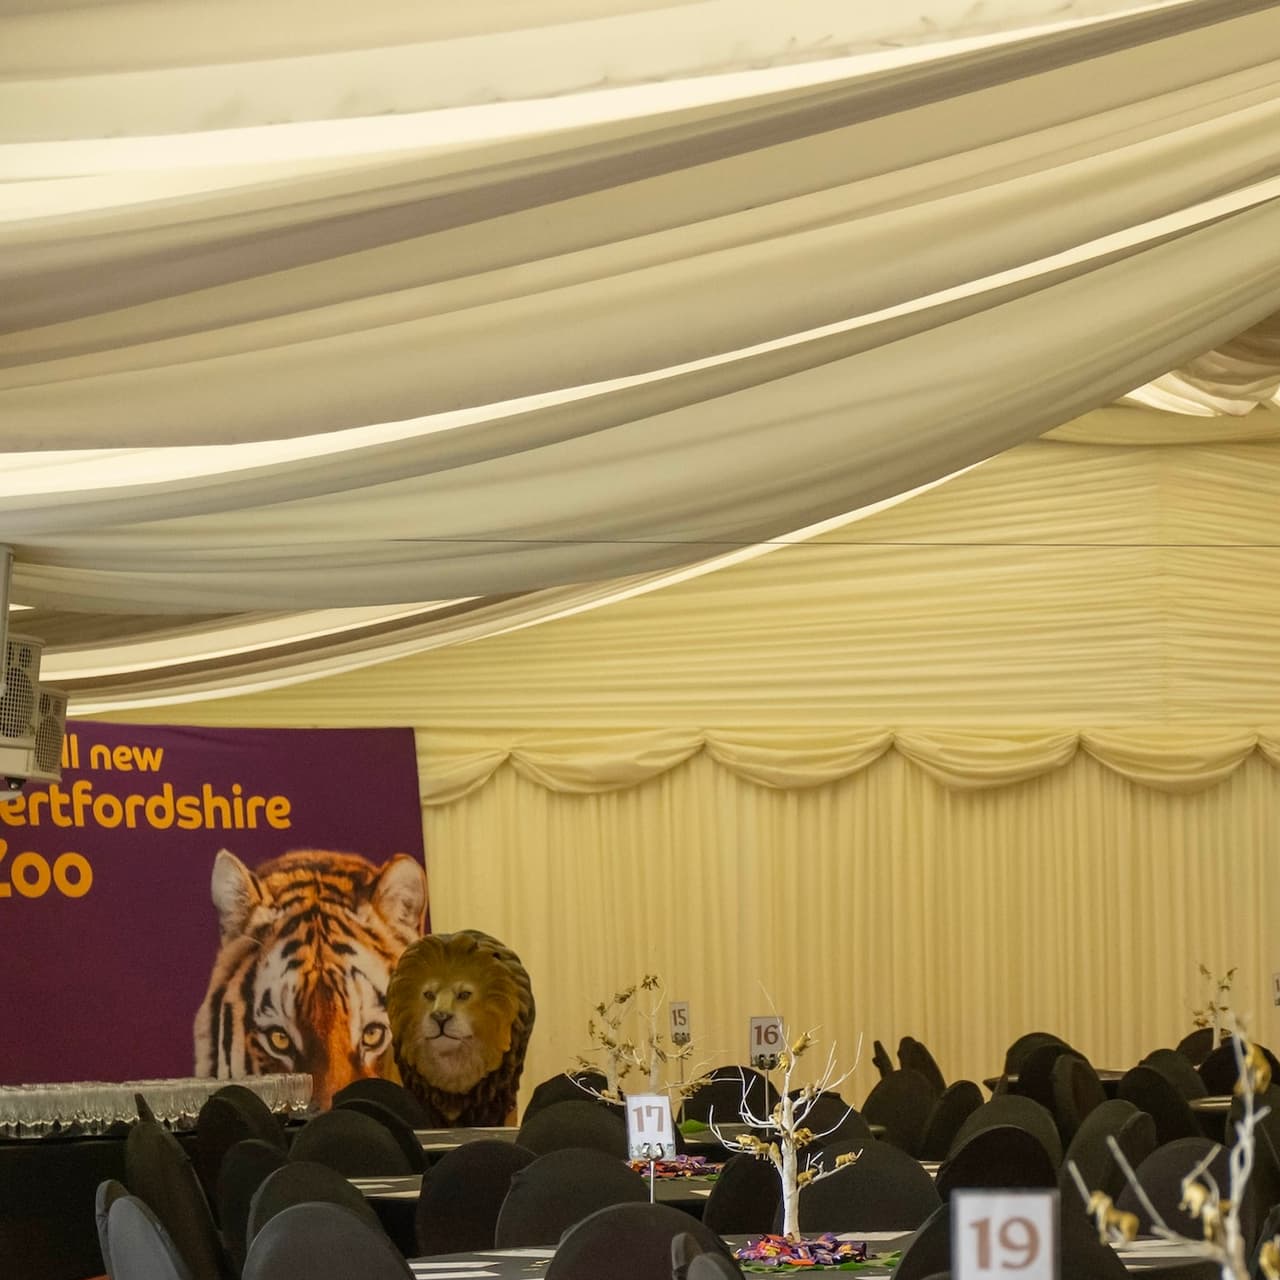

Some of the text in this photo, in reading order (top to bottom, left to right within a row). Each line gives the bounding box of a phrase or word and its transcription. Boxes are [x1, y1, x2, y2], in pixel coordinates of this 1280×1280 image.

[61, 733, 164, 772] ll new
[0, 779, 293, 830] ertfordshire
[671, 1008, 687, 1026] 15
[754, 1024, 779, 1046] 16
[631, 1104, 664, 1133] 17
[968, 1215, 1041, 1271] 19
